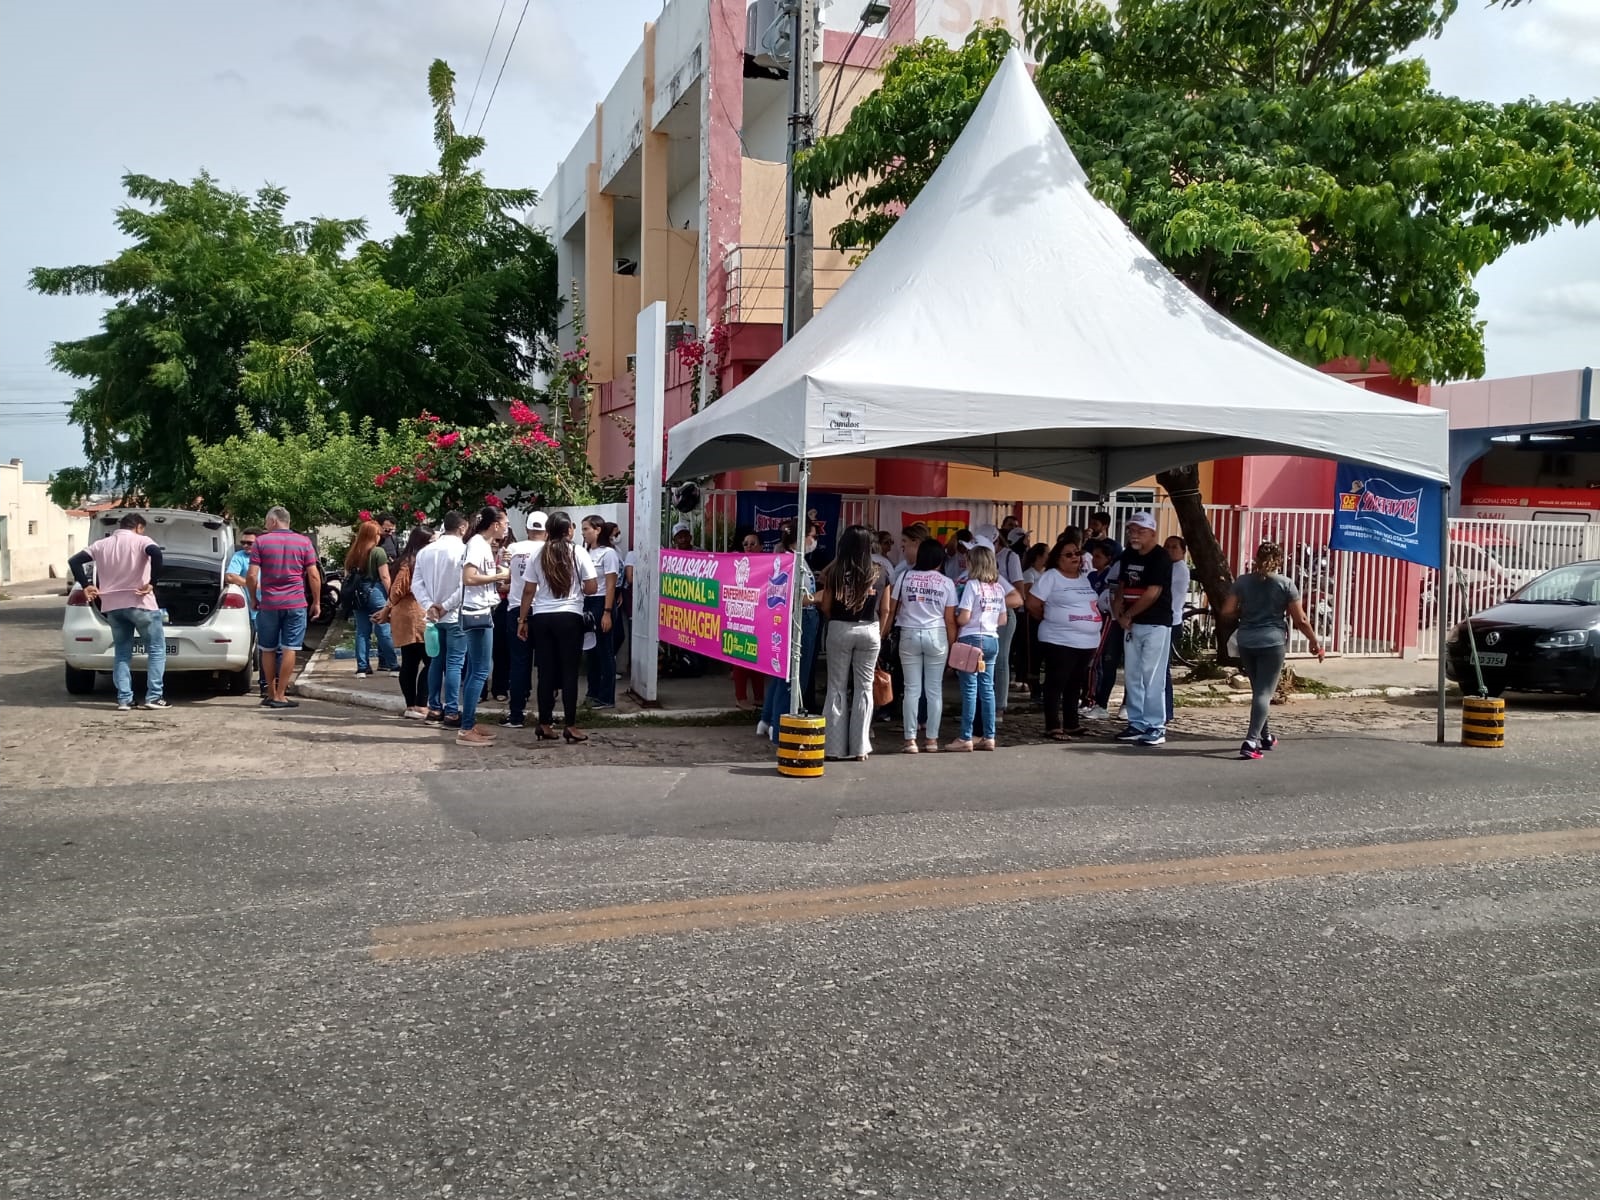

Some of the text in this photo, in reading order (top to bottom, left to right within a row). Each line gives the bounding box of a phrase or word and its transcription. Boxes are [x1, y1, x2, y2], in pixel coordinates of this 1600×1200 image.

[661, 554, 719, 581] PARALISAÇÃO
[662, 575, 707, 603] NACIONAL
[723, 587, 759, 605] ENFERMAGEM
[659, 602, 721, 642] ENFERMAGEM
[722, 632, 733, 655] 10
